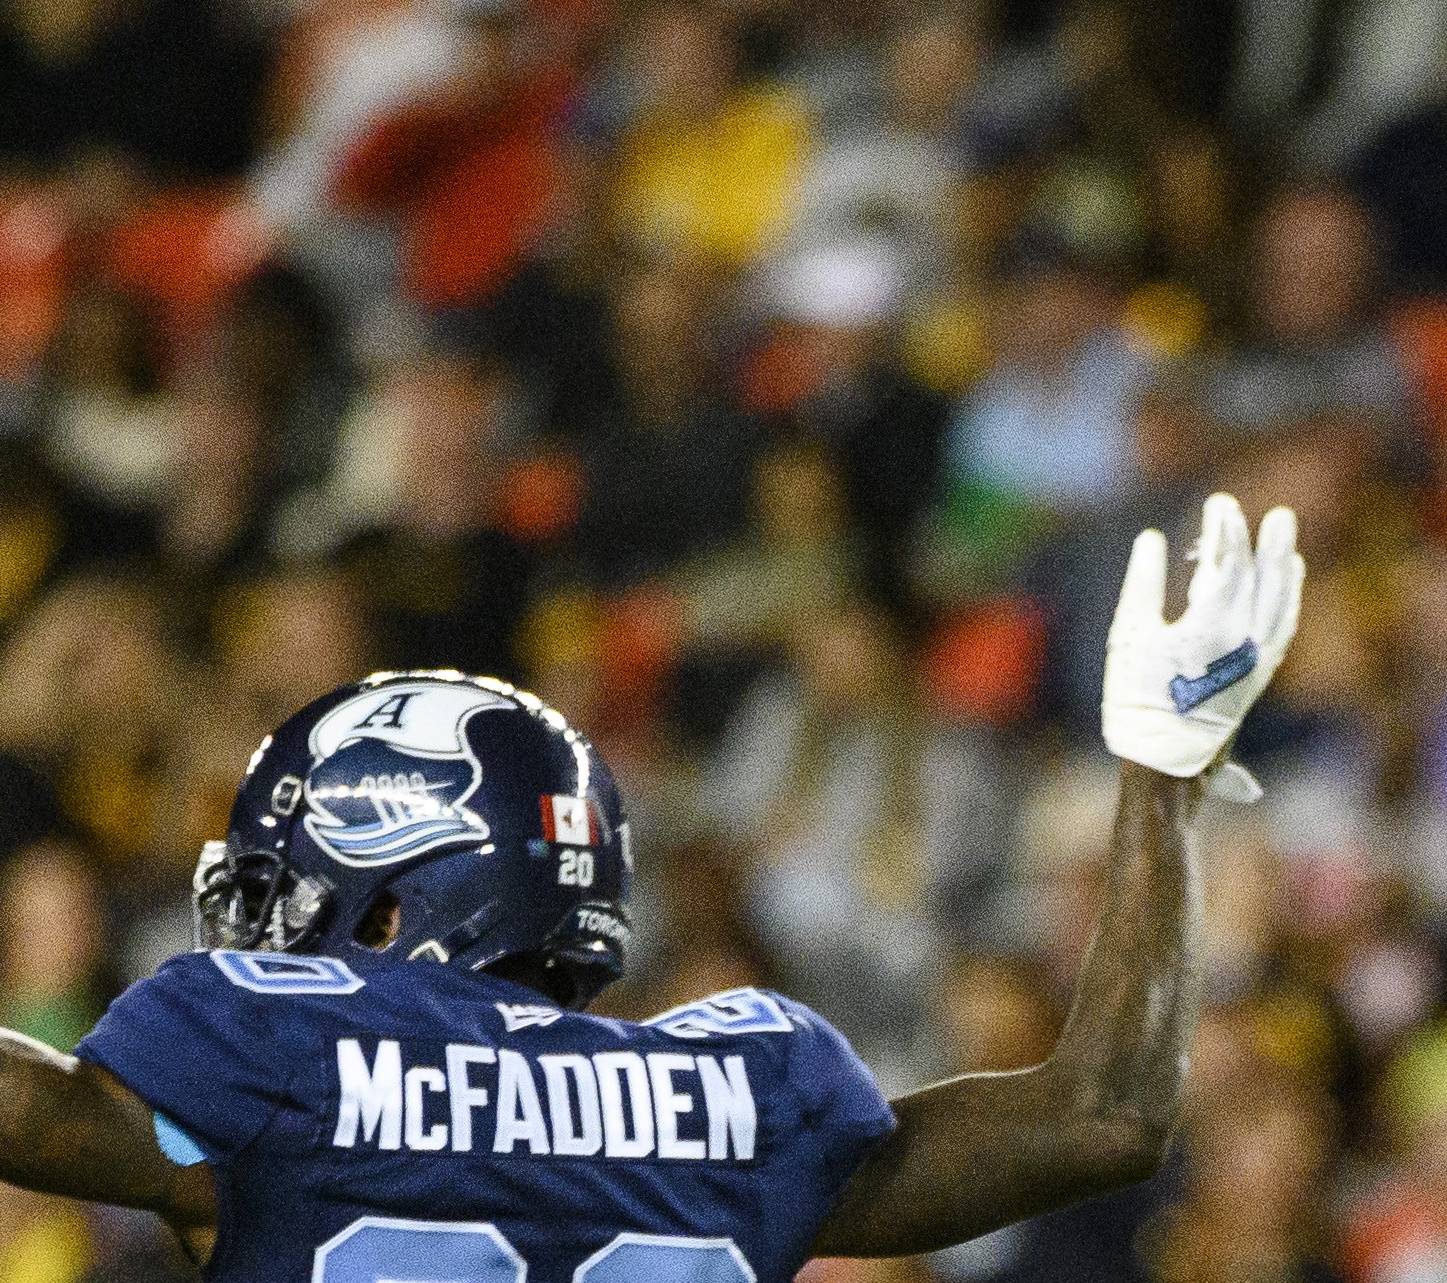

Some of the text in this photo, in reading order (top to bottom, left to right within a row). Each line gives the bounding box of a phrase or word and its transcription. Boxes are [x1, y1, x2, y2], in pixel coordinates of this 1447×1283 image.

[353, 691, 424, 730] A
[557, 848, 595, 888] 20
[333, 1038, 758, 1163] McFADDEN
